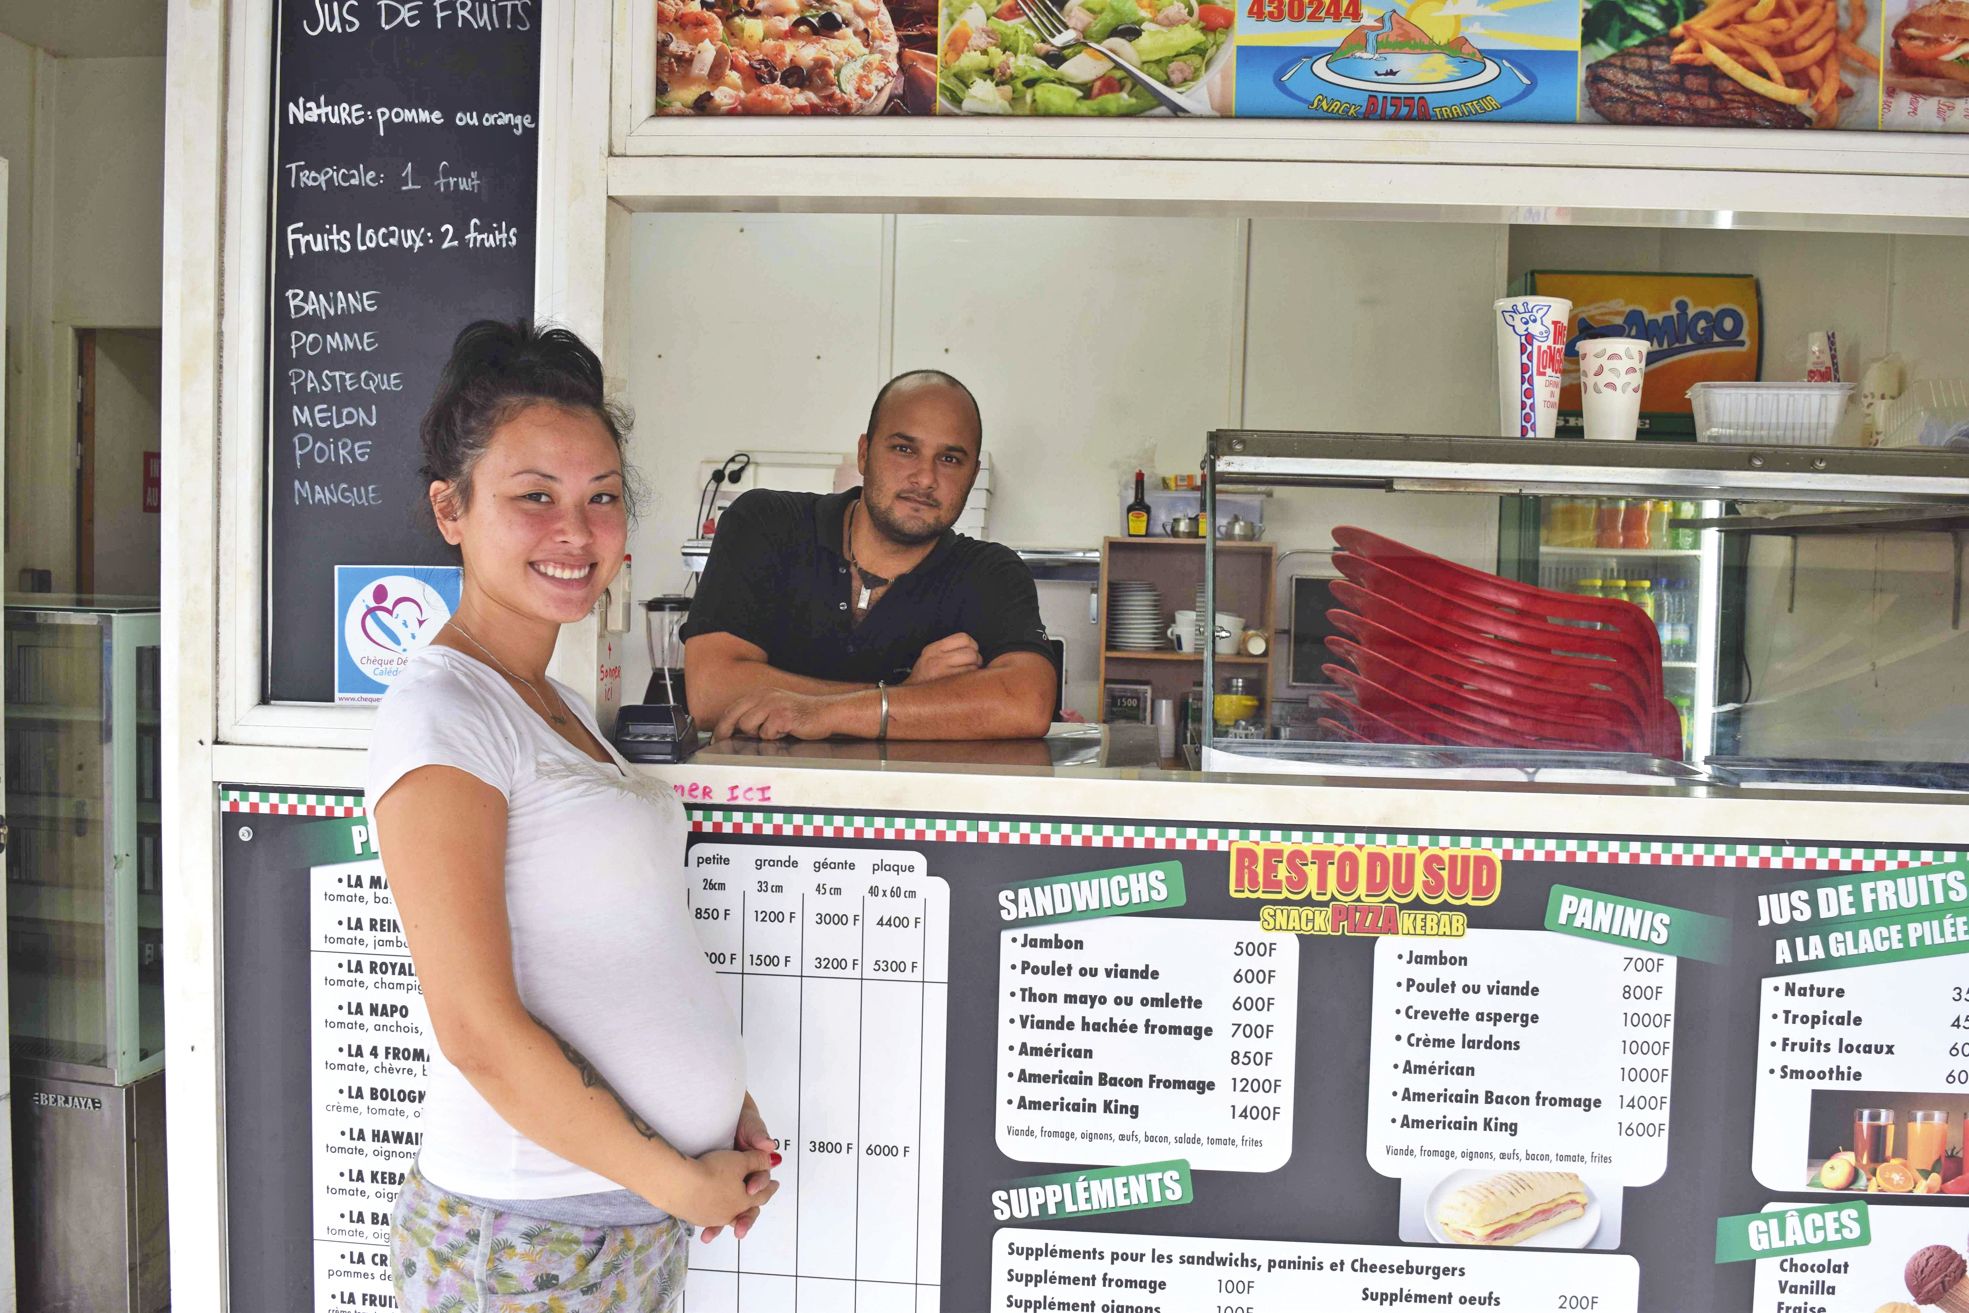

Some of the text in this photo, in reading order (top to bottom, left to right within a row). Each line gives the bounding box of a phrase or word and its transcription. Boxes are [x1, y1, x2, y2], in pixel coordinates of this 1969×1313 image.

[303, 0, 360, 36] JUS
[377, 0, 423, 30] DE
[1247, 0, 1362, 22] 430244
[1308, 93, 1502, 120] SNACK PIZZA TRAITEUR
[455, 111, 478, 126] ou
[482, 111, 535, 136] orange
[400, 162, 421, 190] 1
[287, 222, 351, 258] Fruits
[440, 224, 458, 249] 2
[465, 218, 518, 248] fruits
[285, 288, 382, 319] BANANE
[290, 330, 379, 358] POMME
[288, 368, 403, 395] PASTEQUE
[292, 404, 377, 428] MELON
[293, 479, 383, 506] MANGUE
[726, 784, 772, 802] ICI
[697, 853, 730, 868] petite
[755, 855, 798, 870] grande
[813, 858, 855, 872] géante
[873, 859, 914, 875] plaque
[1234, 847, 1498, 900] RESTO DU SUD
[757, 881, 783, 893] 33 cm
[816, 883, 841, 895] 45 cm
[868, 886, 879, 897] 40
[890, 887, 901, 898] 60
[904, 890, 916, 898] cm
[998, 870, 1168, 921] SANDWICHS
[1757, 870, 1968, 927] JUS DE FRUITS
[695, 907, 730, 920] 850 F
[755, 910, 795, 923] 1200 F
[816, 913, 859, 926] 3000 F
[876, 916, 920, 928] 4400 F
[1261, 904, 1466, 936] SNACK PIZZA KEBAB
[1558, 894, 1672, 945] PANINIS
[1021, 934, 1276, 957] Jambon 500F
[1775, 914, 1969, 965] A LA GLACE PILÉE
[749, 954, 780, 967] 1500
[815, 957, 847, 970] 3200
[873, 960, 906, 972] 5300
[1407, 950, 1664, 972] Jambon 700F
[1021, 961, 1275, 984] Poulet ou viande 600F
[1020, 987, 1275, 1011] Thon mayo ou omlette 600F
[1407, 978, 1662, 1000] Poulet ou viande 800F
[1785, 982, 1845, 998] Nature
[348, 1002, 408, 1018] LA NAPO
[1405, 1006, 1671, 1028] Crevette asperge 1000F
[1783, 1010, 1862, 1029] Tropicale
[325, 1018, 424, 1036] tomate, anchois,
[1019, 1014, 1273, 1040] Viande hachée fromage 700F
[348, 1044, 363, 1058] LA
[370, 1046, 378, 1059] 4
[1407, 1033, 1671, 1056] Crème lardons 1000F
[1782, 1038, 1895, 1055] Fruits locaux
[325, 1059, 417, 1077] tomate, chèvre,
[1780, 1065, 1862, 1081] Smoothie
[1017, 1069, 1281, 1095] Americain Bacon Fromage 1200F
[40, 1093, 94, 1111] BERJAYA
[1402, 1088, 1667, 1112] Americain Bacon fromage 1400F
[809, 1141, 842, 1153] 3800
[1007, 1125, 1038, 1140] Viande,
[1040, 1126, 1078, 1142] fromage,
[1080, 1128, 1115, 1143] oignons,
[1144, 1130, 1171, 1145] bacon,
[1174, 1131, 1204, 1146] salade,
[1206, 1134, 1238, 1148] tomate,
[1242, 1136, 1262, 1147] frites
[326, 1144, 368, 1158] tomate,
[866, 1144, 898, 1157] 6000
[991, 1169, 1183, 1221] SUPPLÉMENTS
[1748, 1208, 1861, 1251] GLÂCES
[1008, 1242, 1465, 1280] Suppléments pour les sandwichs, paninis et Cheeseburgers
[1780, 1258, 1849, 1274] Chocolat
[1007, 1269, 1254, 1294] Supplément fromage 100F
[1778, 1280, 1835, 1295] Vanilla
[1362, 1288, 1598, 1309] Supplément oeufs 200F
